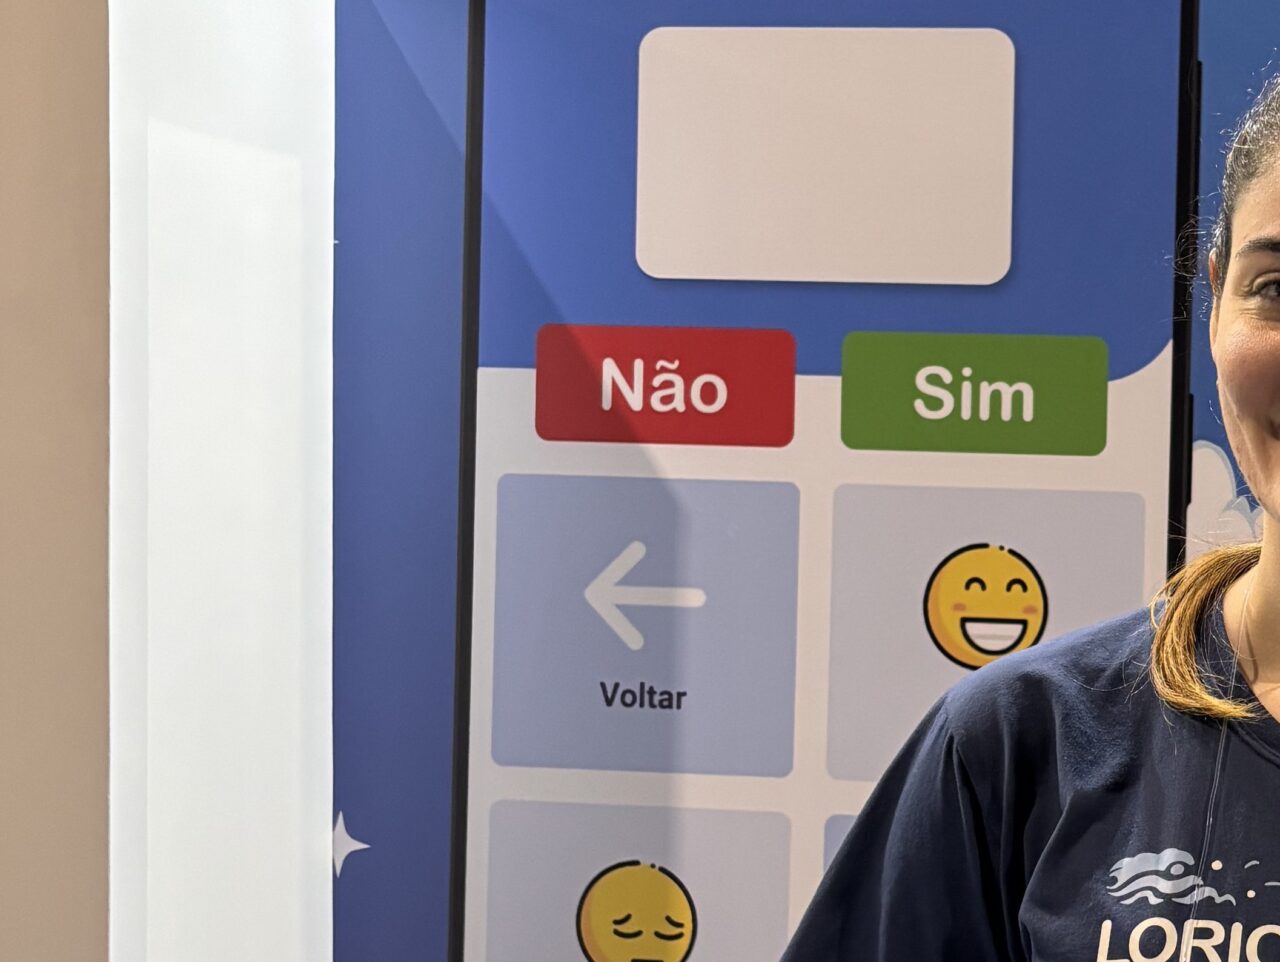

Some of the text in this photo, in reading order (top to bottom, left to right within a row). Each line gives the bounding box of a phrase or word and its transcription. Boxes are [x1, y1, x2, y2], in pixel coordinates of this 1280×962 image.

[601, 357, 730, 415] Não
[913, 365, 1036, 424] Sim
[600, 681, 689, 712] Voltar
